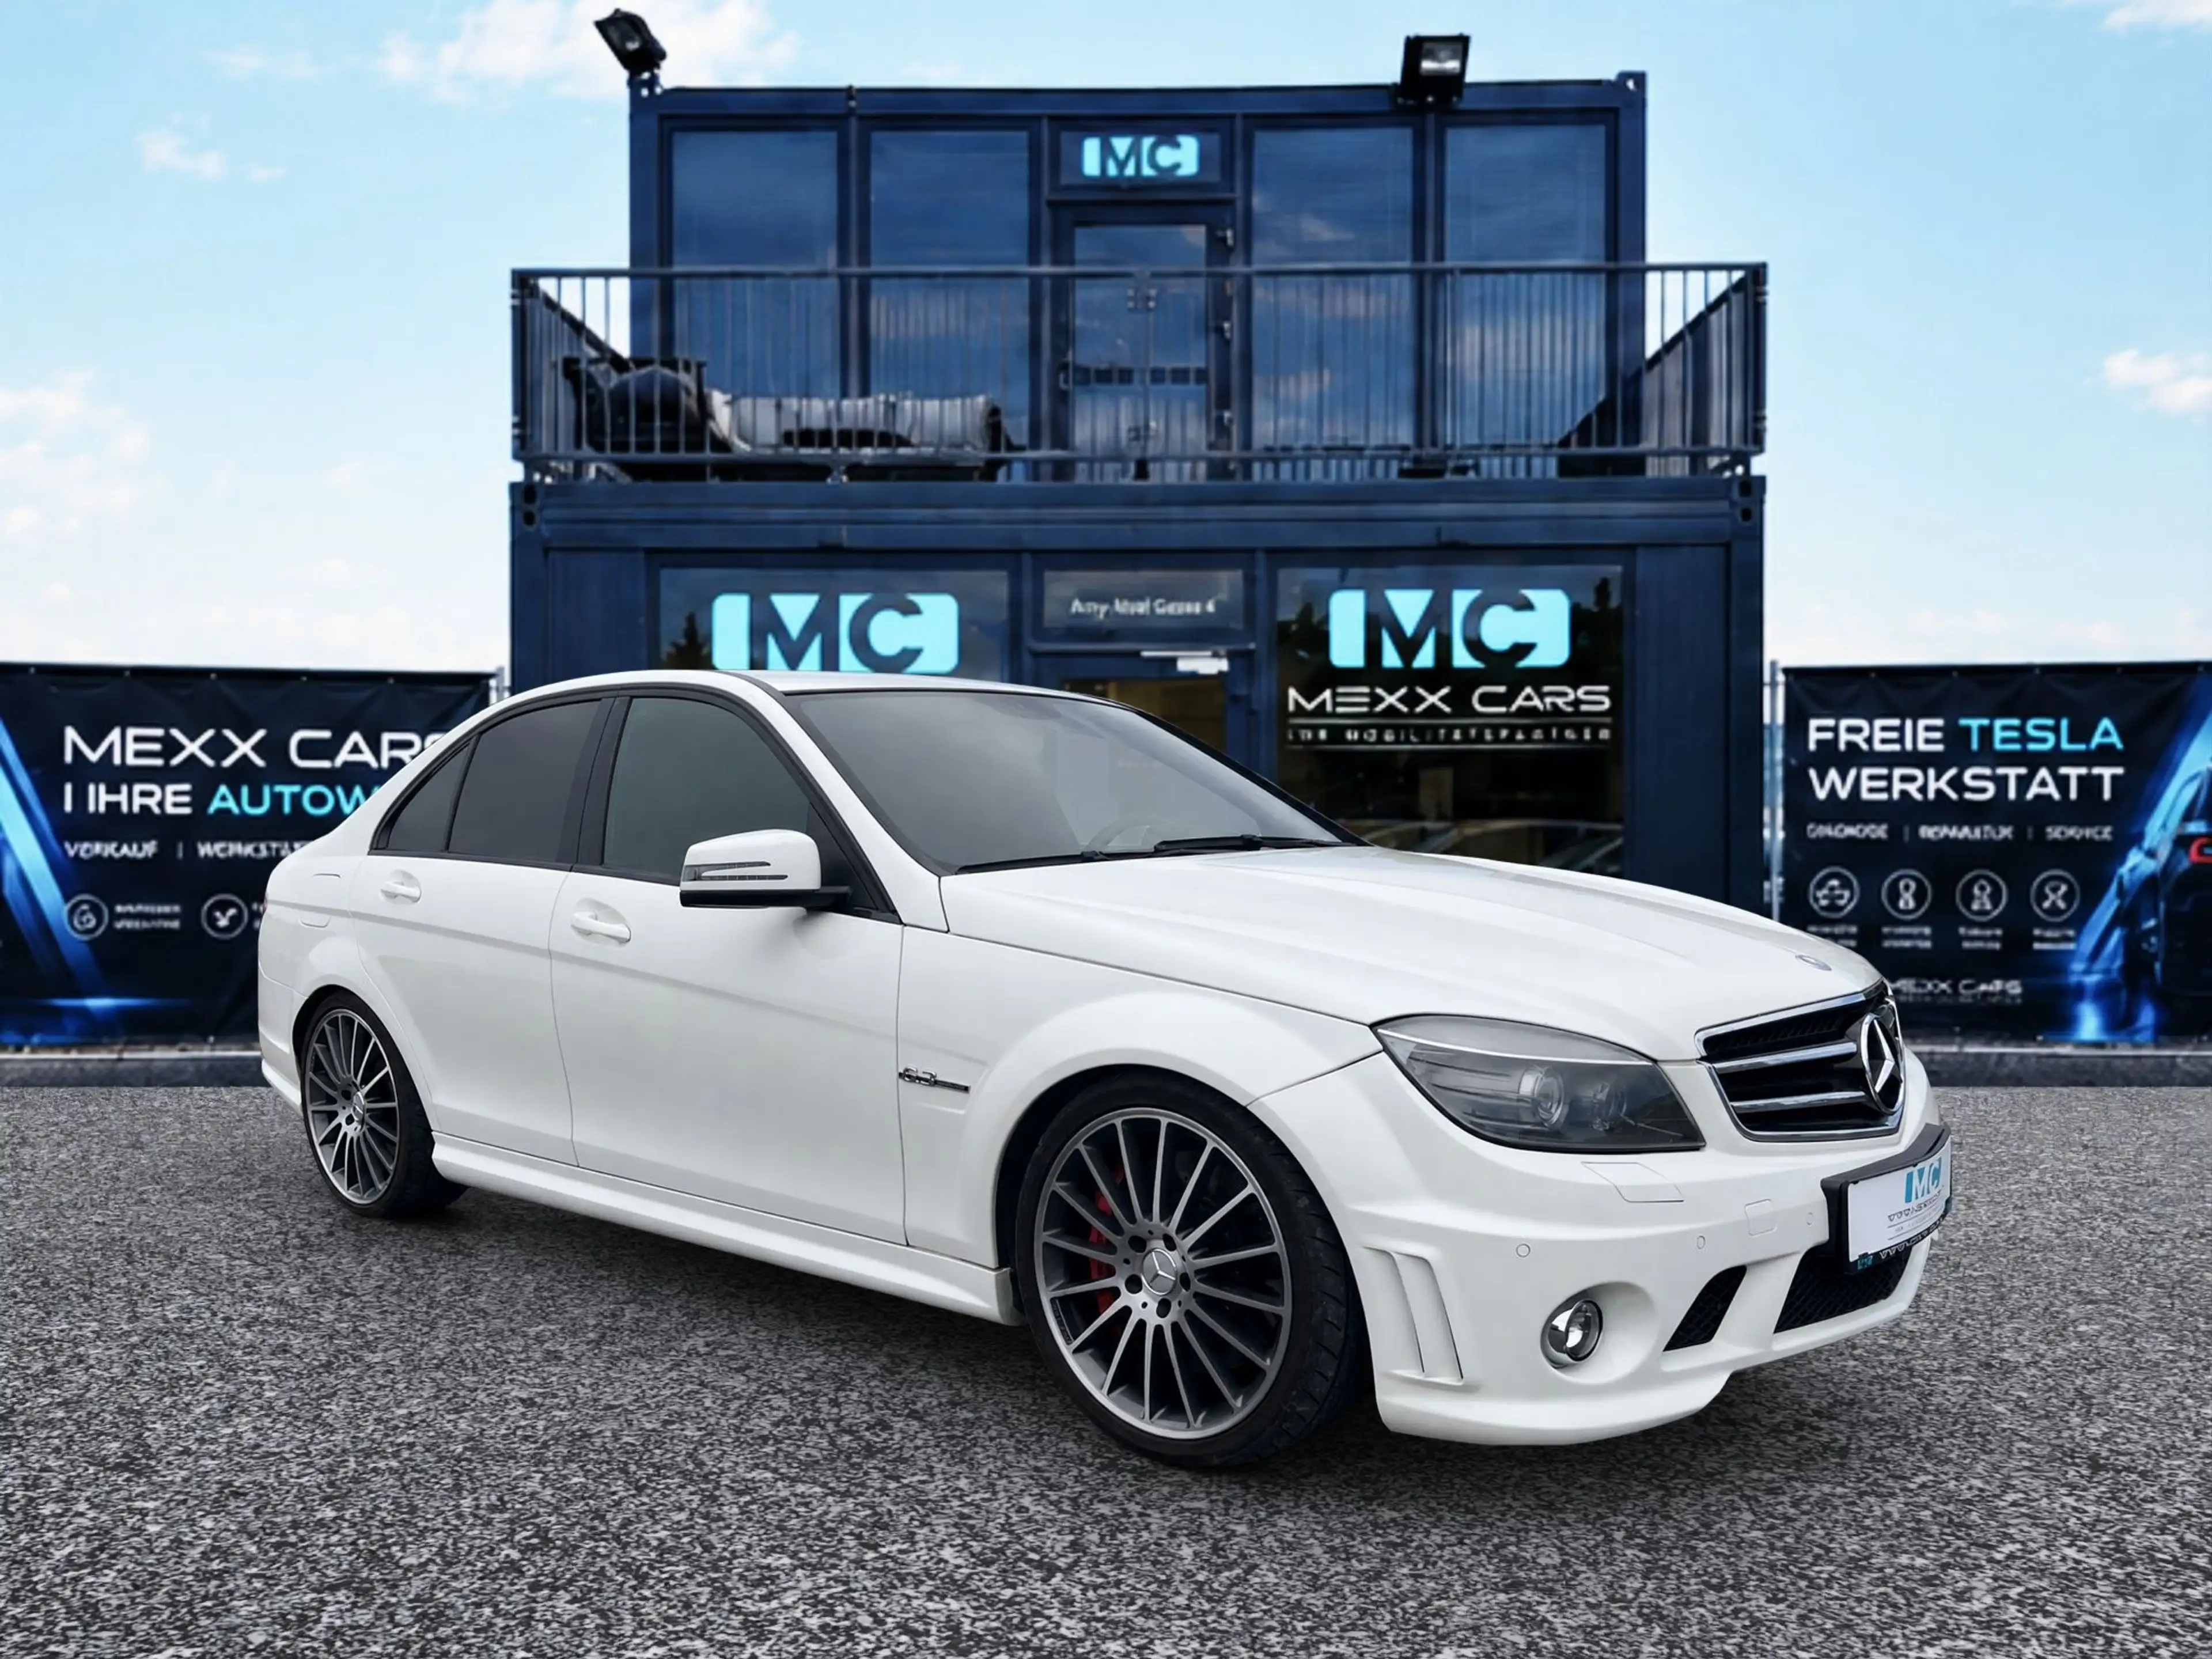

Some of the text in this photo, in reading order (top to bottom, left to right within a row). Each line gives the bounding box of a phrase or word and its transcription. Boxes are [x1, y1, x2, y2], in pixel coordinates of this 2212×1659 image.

[1083, 135, 1199, 177] MC
[712, 593, 959, 673] MC
[1330, 589, 1569, 668] MC
[1287, 686, 1611, 713] MEXX CARS
[65, 727, 267, 768] MEXX
[1809, 718, 2124, 752] FREIE TESLA
[88, 784, 192, 814] IHRE
[1808, 767, 2124, 801] WERKSTATT
